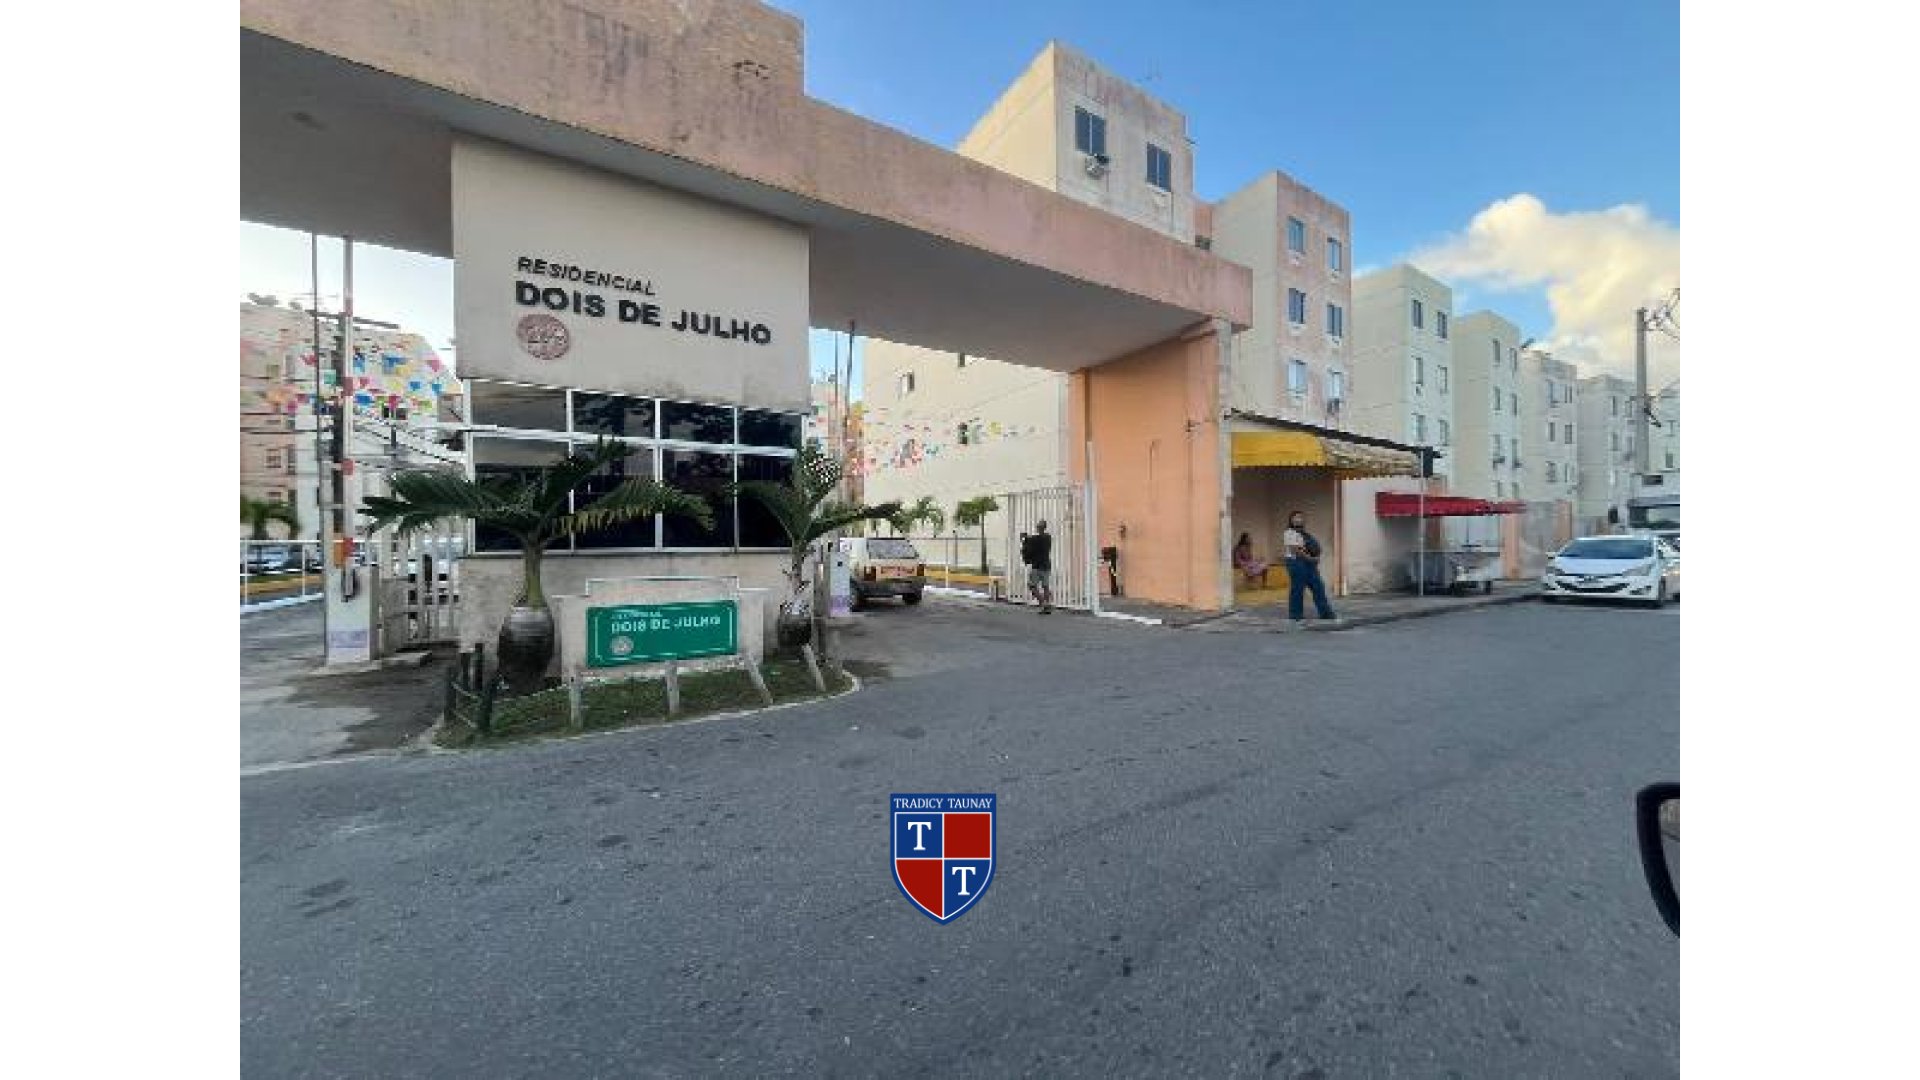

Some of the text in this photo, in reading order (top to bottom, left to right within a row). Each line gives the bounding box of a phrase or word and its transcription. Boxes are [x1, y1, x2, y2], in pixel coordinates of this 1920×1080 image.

[517, 256, 656, 296] RESIDENCIAL
[515, 280, 771, 344] DOIS DE JULHO
[650, 618, 670, 630] DE
[673, 616, 721, 628] JULHO
